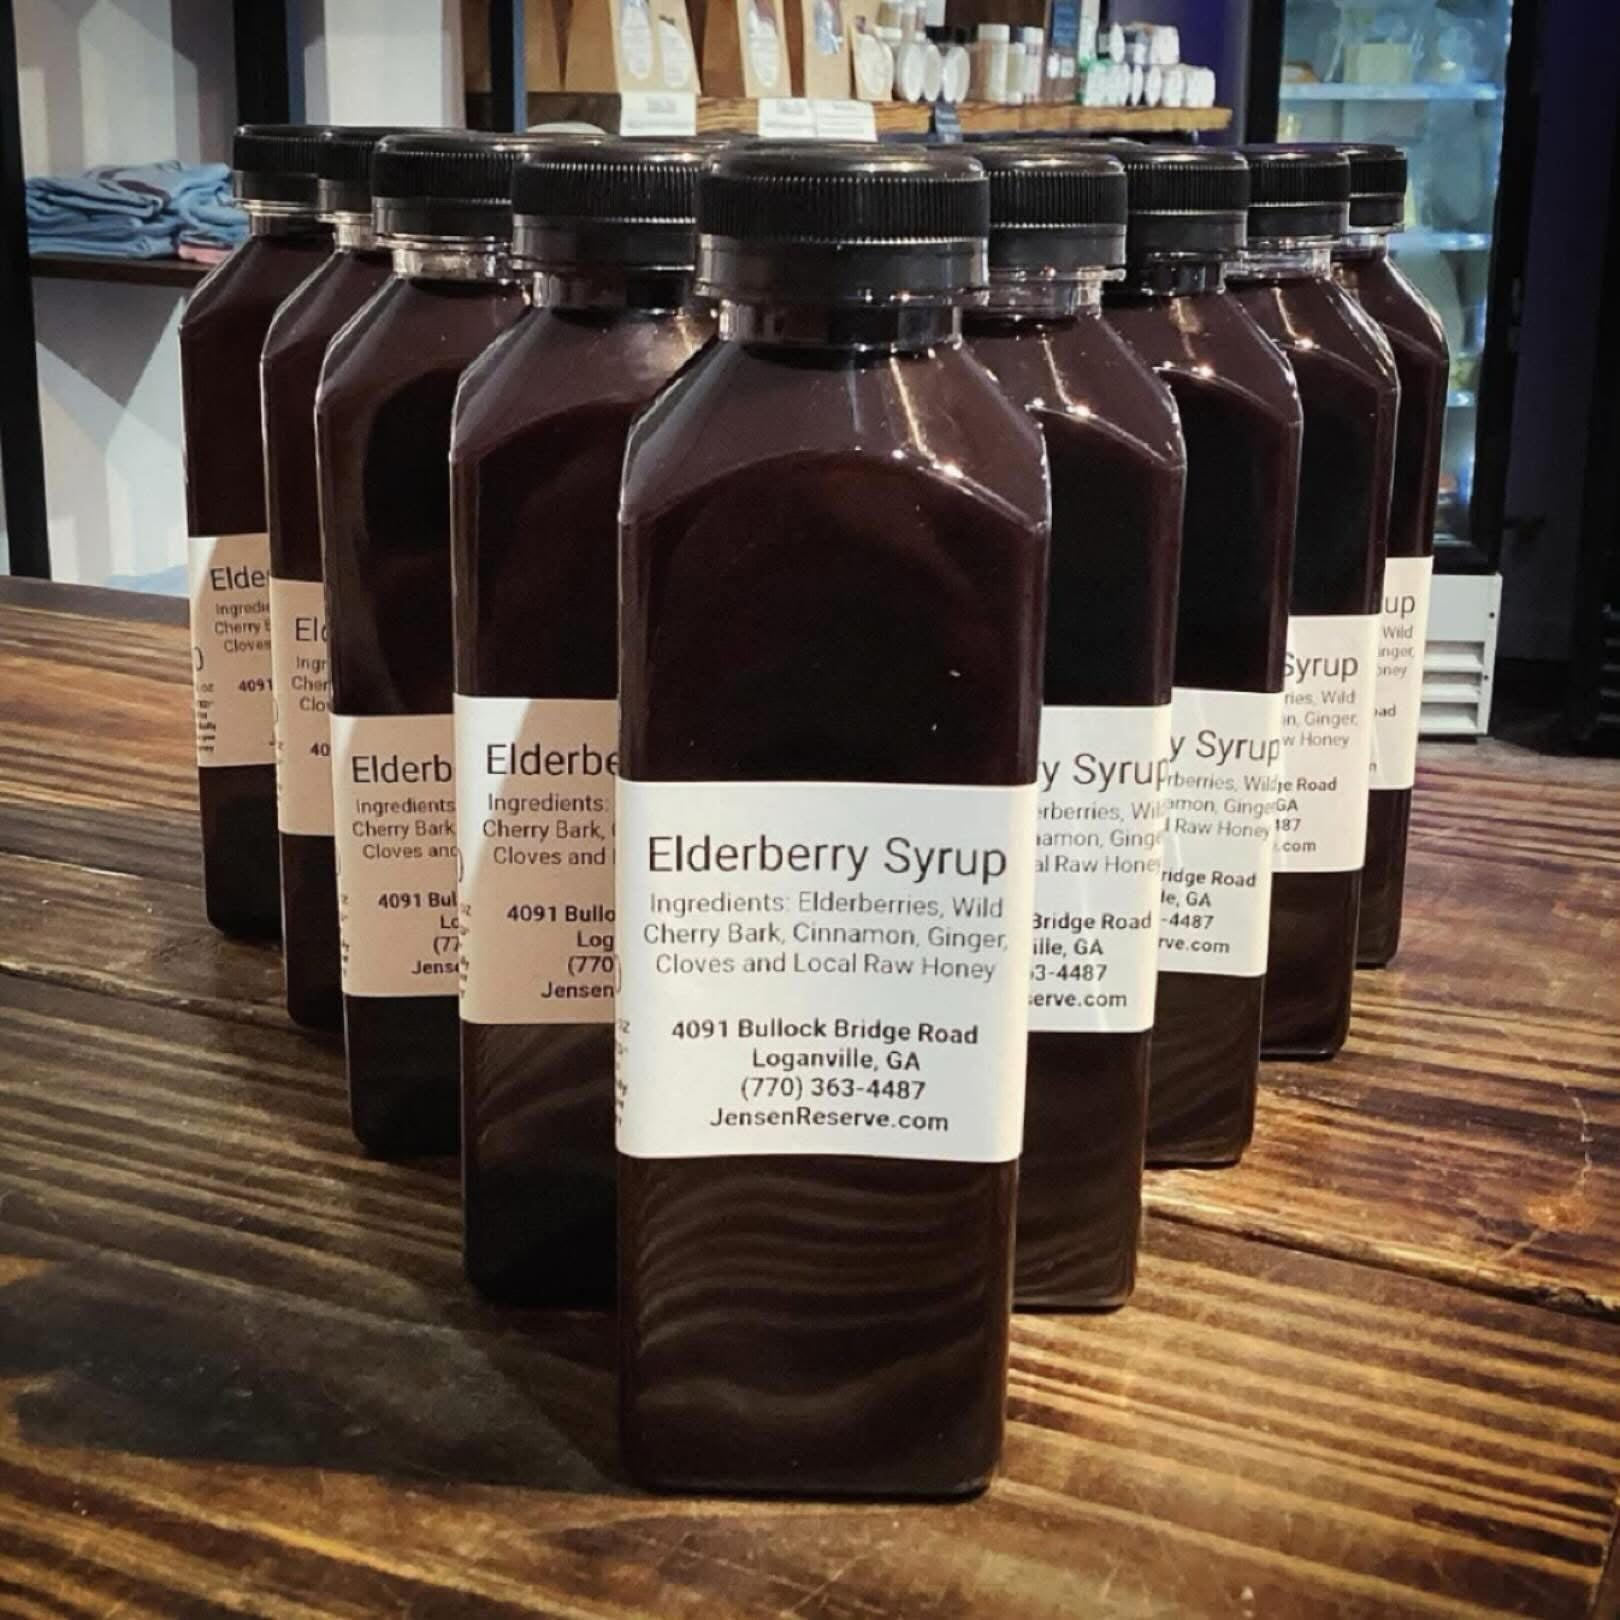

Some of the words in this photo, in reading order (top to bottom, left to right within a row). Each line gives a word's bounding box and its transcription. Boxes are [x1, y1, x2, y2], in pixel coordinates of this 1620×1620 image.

[214, 621, 261, 635] Cherry
[1383, 624, 1414, 640] Wild
[238, 677, 273, 692] 4091
[1320, 689, 1356, 705] Wild
[1195, 729, 1281, 768] Syrup
[1300, 731, 1350, 749] Honey
[351, 753, 453, 783] Elderb
[1296, 776, 1338, 792] Road
[351, 820, 409, 841] Cherry
[483, 819, 550, 844] Cherry
[556, 819, 605, 841] Bark,
[1175, 818, 1213, 835] Raw
[1217, 820, 1270, 841] Honey
[362, 844, 423, 860] Cloves
[494, 846, 562, 865] Cloves
[568, 846, 606, 865] and
[648, 834, 869, 883] Elderberry
[884, 836, 1007, 886] Syrup
[1054, 854, 1099, 873] Raw
[1211, 870, 1257, 888] Road
[378, 892, 422, 909] 4091
[650, 891, 791, 919] Ingredients:
[799, 890, 945, 920] Elderberries,
[952, 896, 1004, 919] Wild
[1186, 891, 1212, 908] GA
[507, 904, 558, 922] 4091
[1101, 910, 1153, 930] Road
[643, 921, 721, 948] Cherry
[728, 921, 786, 945] Bark,
[793, 921, 920, 948] Cinnamon,
[927, 925, 1008, 954] Ginger,
[1073, 938, 1105, 956] GA
[656, 952, 735, 974] Cloves
[743, 951, 786, 973] and
[793, 951, 857, 974] Local
[863, 952, 915, 975] Raw
[921, 955, 997, 983] Honey
[672, 1018, 728, 1040] 4091
[738, 1016, 827, 1038] Bullock
[834, 1017, 911, 1045] Bridge
[918, 1022, 979, 1045] Road
[752, 1047, 879, 1072] Loganville,
[886, 1050, 921, 1072] GA
[740, 1075, 804, 1101] (770)
[811, 1077, 926, 1100] 363-4487
[709, 1106, 949, 1132] JensenReserve.com
